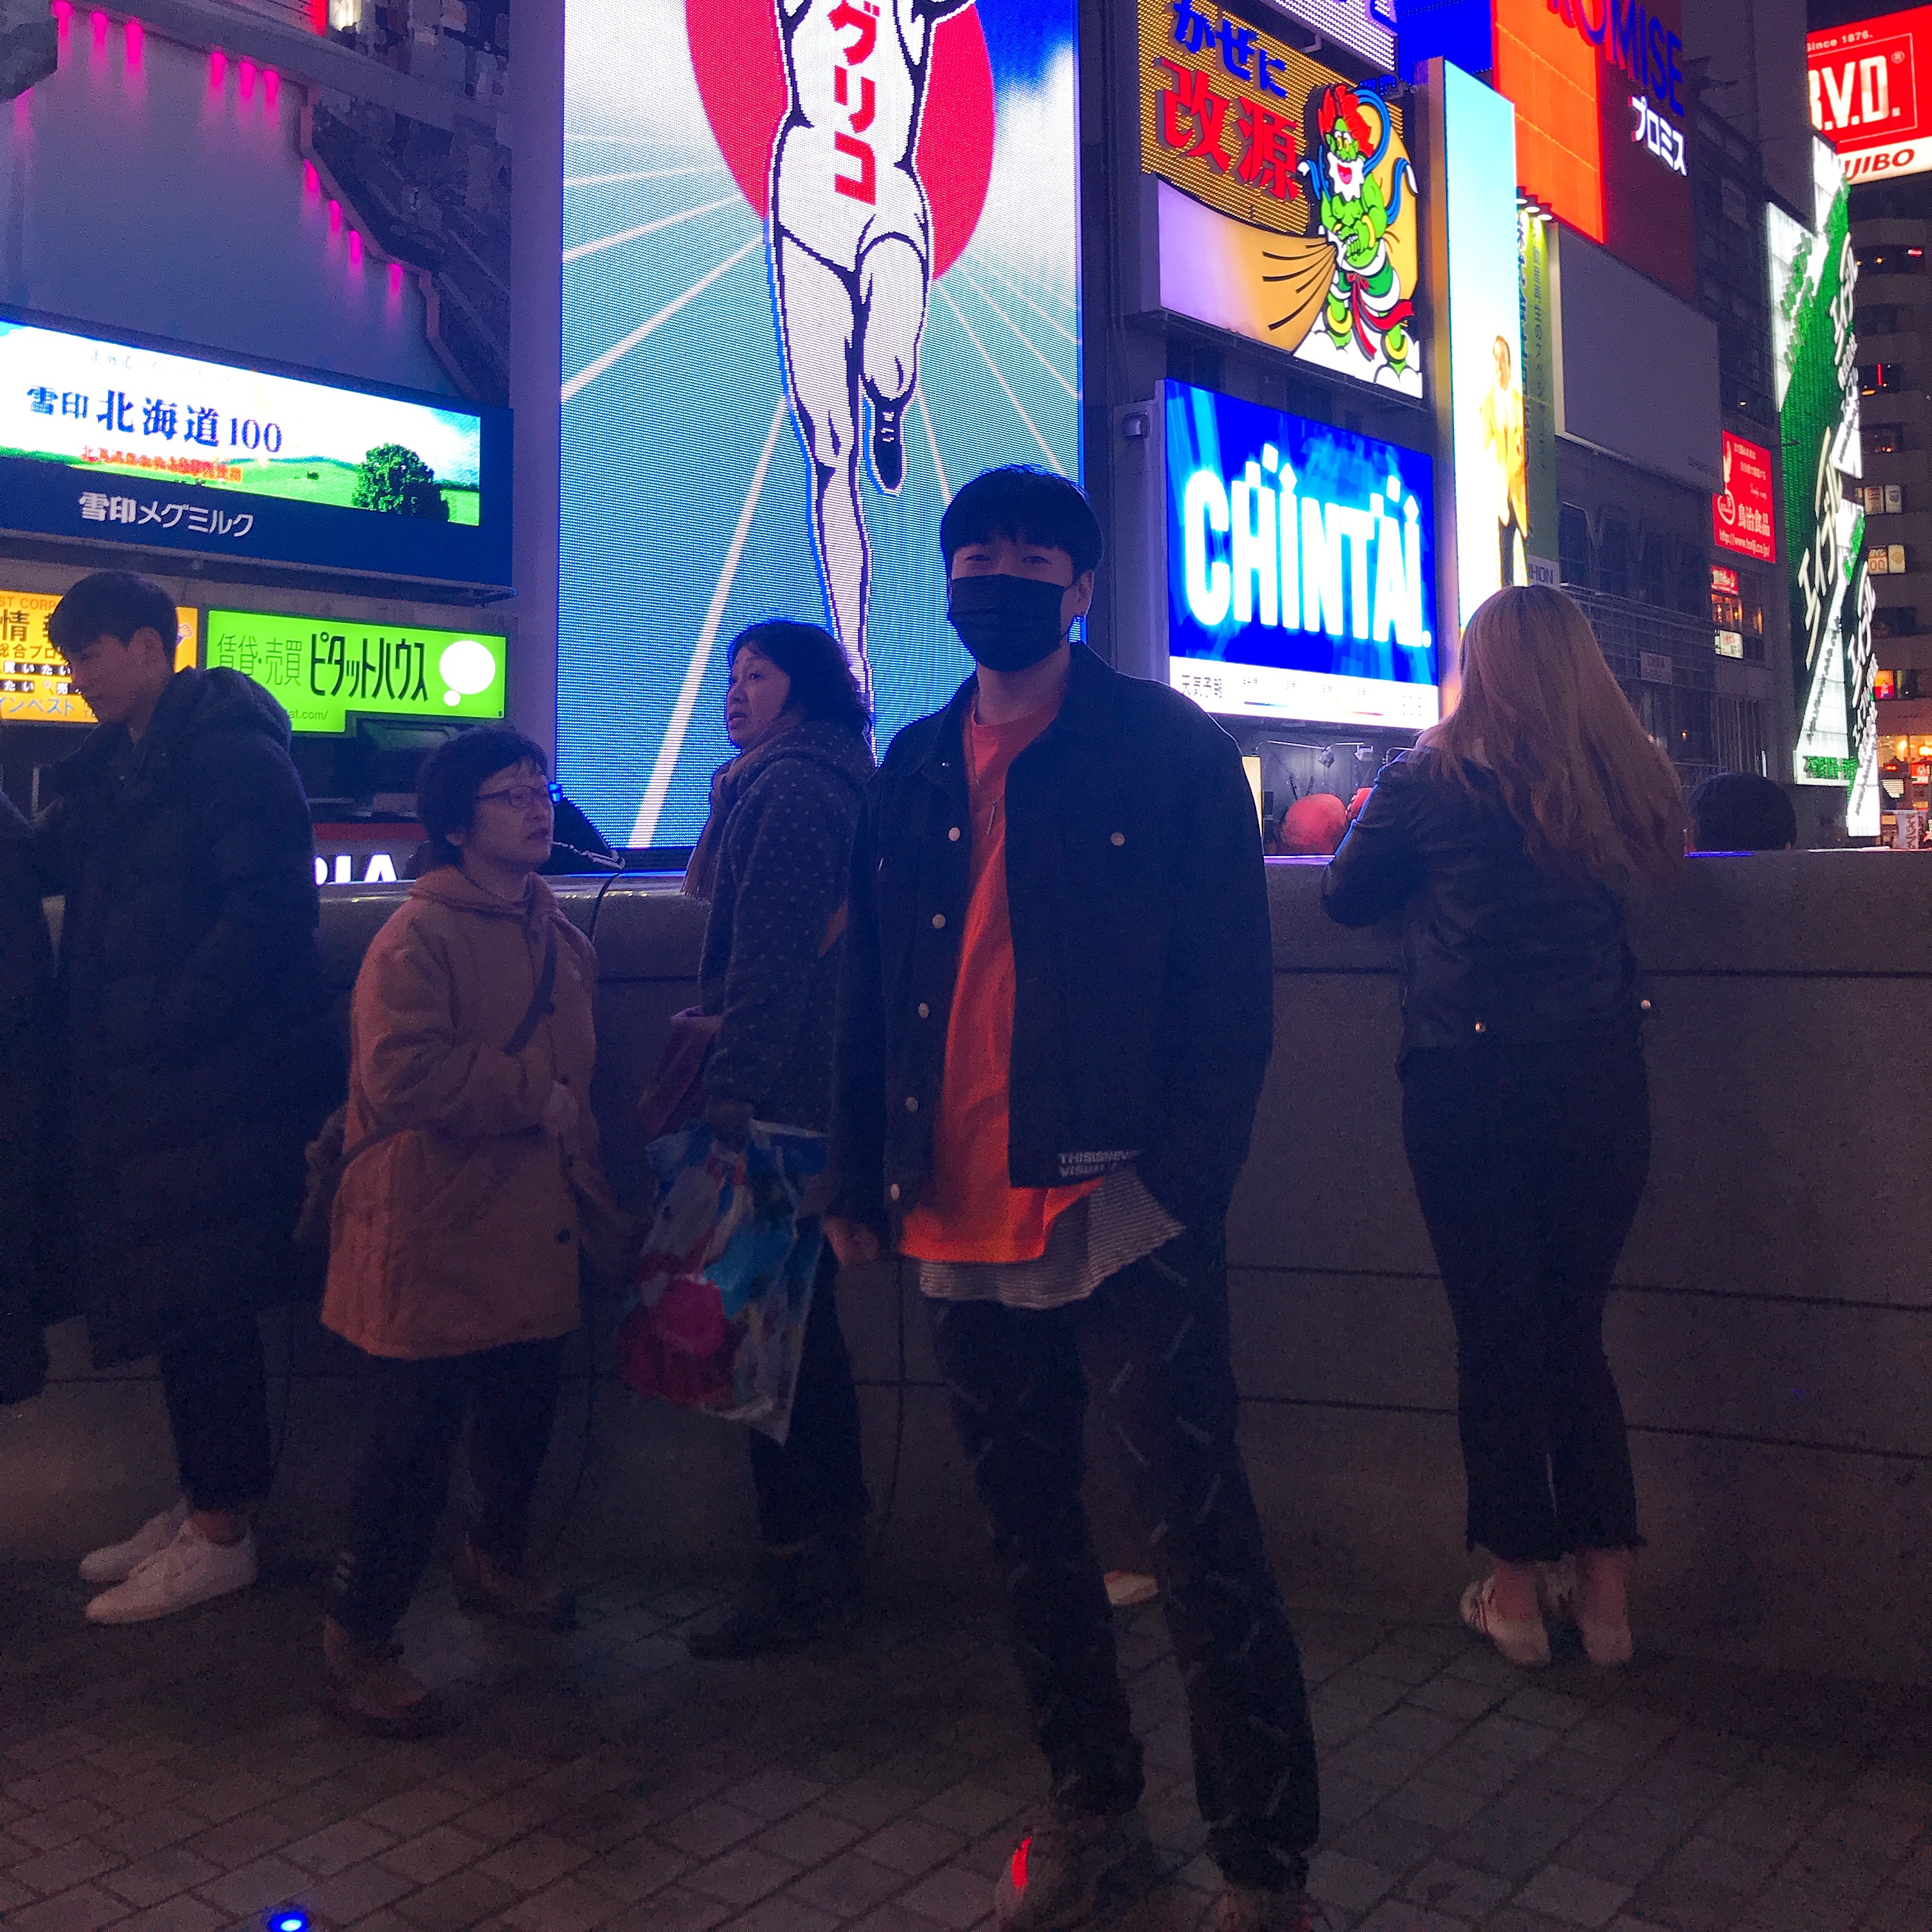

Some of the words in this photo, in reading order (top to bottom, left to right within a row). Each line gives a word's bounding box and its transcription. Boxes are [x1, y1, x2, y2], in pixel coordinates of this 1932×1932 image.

[1160, 57, 1300, 201] 改源
[1629, 95, 1688, 176] プロミス
[79, 492, 254, 537] 雪印メグミルク
[310, 631, 429, 702] ピタットハウス
